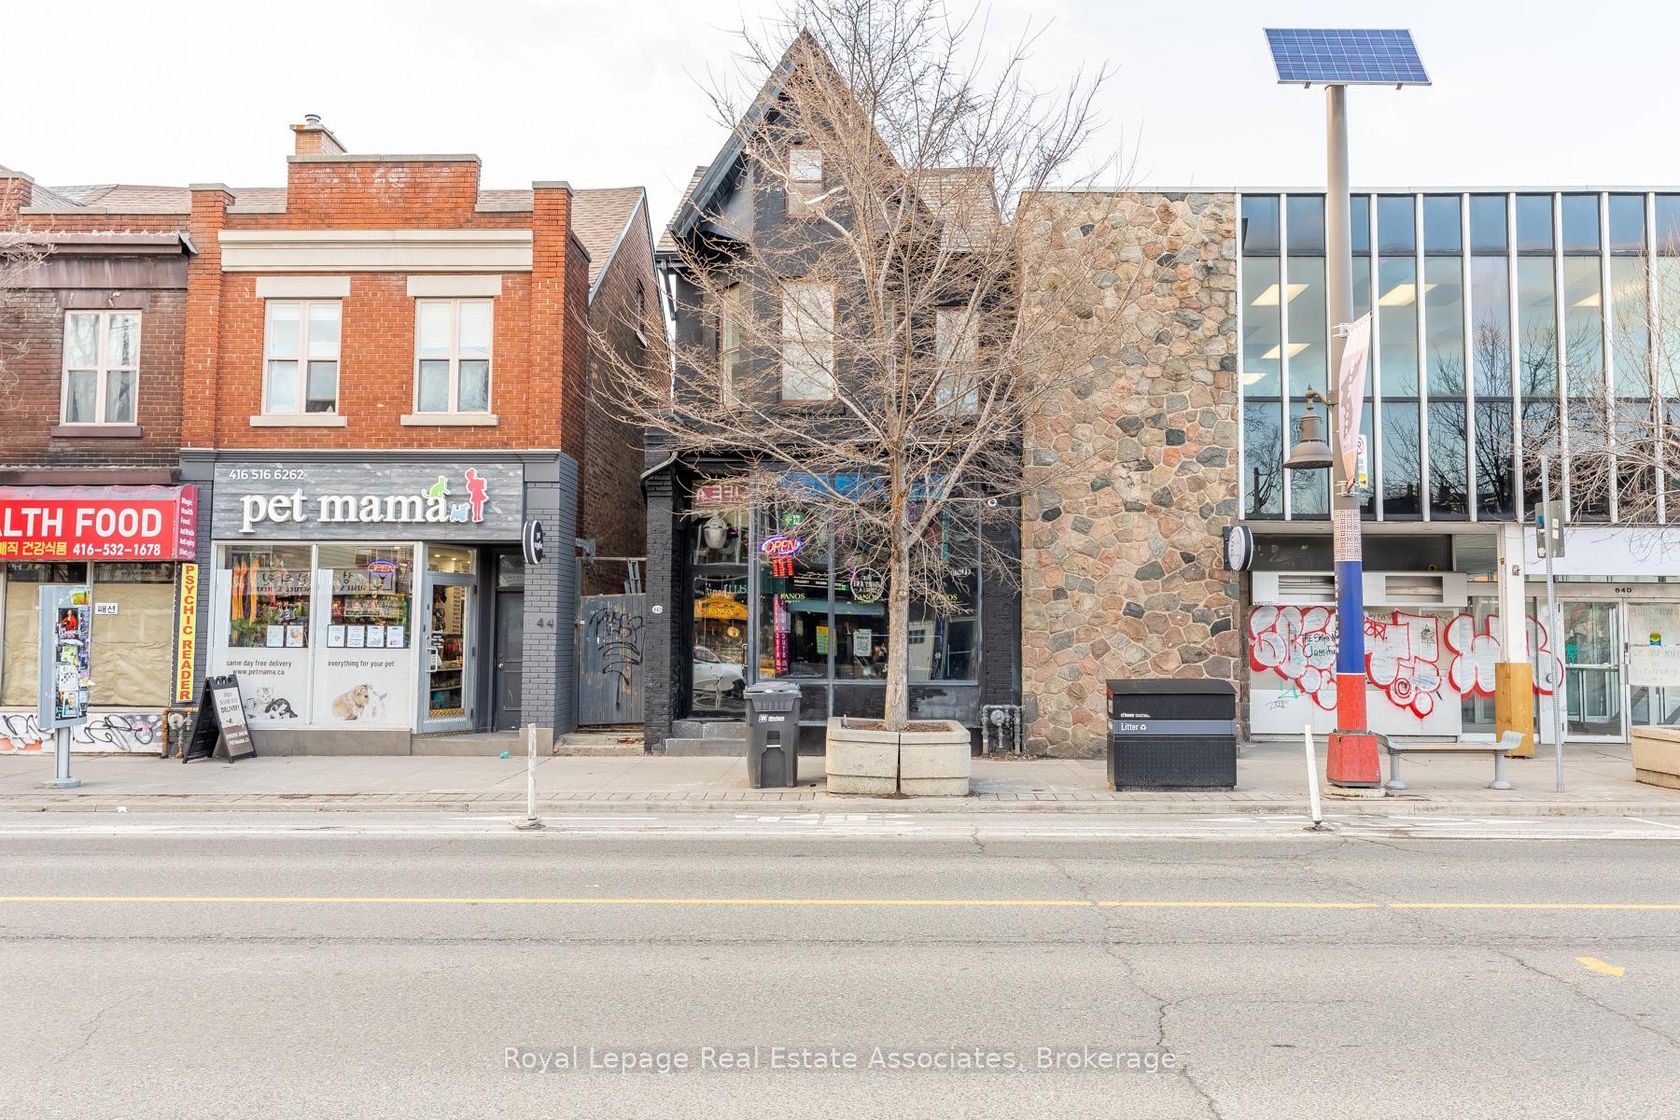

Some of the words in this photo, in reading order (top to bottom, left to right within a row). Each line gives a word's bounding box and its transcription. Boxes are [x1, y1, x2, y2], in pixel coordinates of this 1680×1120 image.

[229, 469, 248, 480] 416
[251, 469, 271, 480] 516
[274, 469, 304, 480] 6262
[239, 488, 308, 533] pet
[317, 494, 450, 523] mama
[0, 508, 63, 537] LTH
[75, 508, 162, 538] FOOD
[22, 541, 67, 556] 건강식품
[73, 543, 161, 556] 416-532-1678
[764, 539, 798, 554] OPEN
[182, 565, 195, 635] PSYCHIC
[180, 640, 193, 700] READER
[243, 660, 254, 669] day
[269, 660, 291, 669] delivery
[328, 660, 359, 669] everything
[384, 661, 395, 669] pet
[233, 668, 285, 676] www.petmama.ca
[221, 704, 240, 713] DELIVERY
[1121, 722, 1139, 731] Litter
